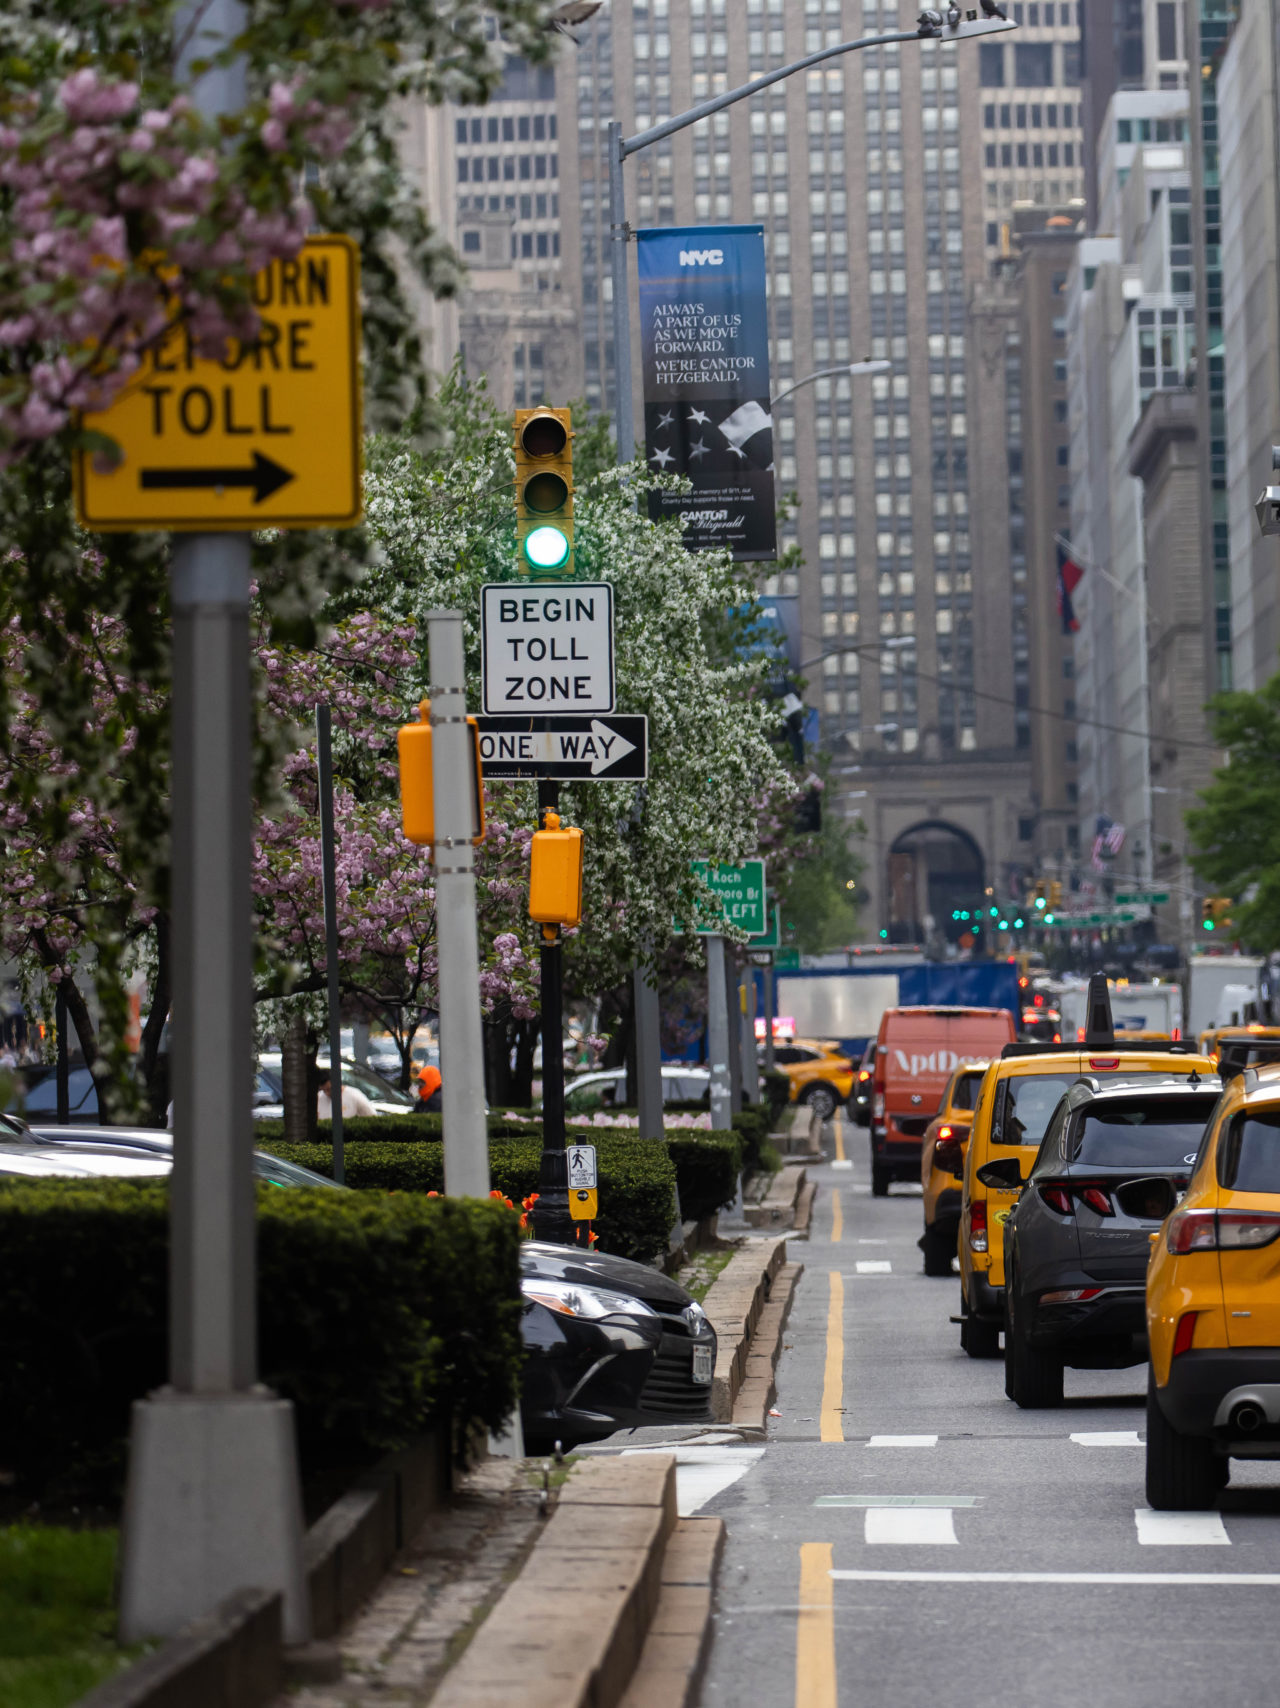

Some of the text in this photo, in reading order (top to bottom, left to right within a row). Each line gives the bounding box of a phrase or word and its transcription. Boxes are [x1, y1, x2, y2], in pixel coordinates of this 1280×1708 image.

[679, 249, 724, 266] NYC
[250, 256, 330, 308] URN
[653, 303, 704, 316] ALWAYS
[653, 314, 741, 329] A PART OF US
[654, 327, 738, 341] AS WE MOVE
[655, 340, 725, 354] FORWARD.
[655, 357, 755, 372] WE'RE CANTOR
[656, 370, 740, 384] FITZGERALD.
[142, 383, 293, 437] TOLL
[680, 509, 728, 520] CANTOR
[693, 515, 745, 533] Fitzgerald
[500, 598, 595, 622] BEGIN
[507, 637, 589, 661] TOLL
[505, 676, 592, 700] ZONE
[480, 735, 616, 759] ONE WAY
[712, 871, 742, 884] Koch
[723, 904, 758, 918] LEFT
